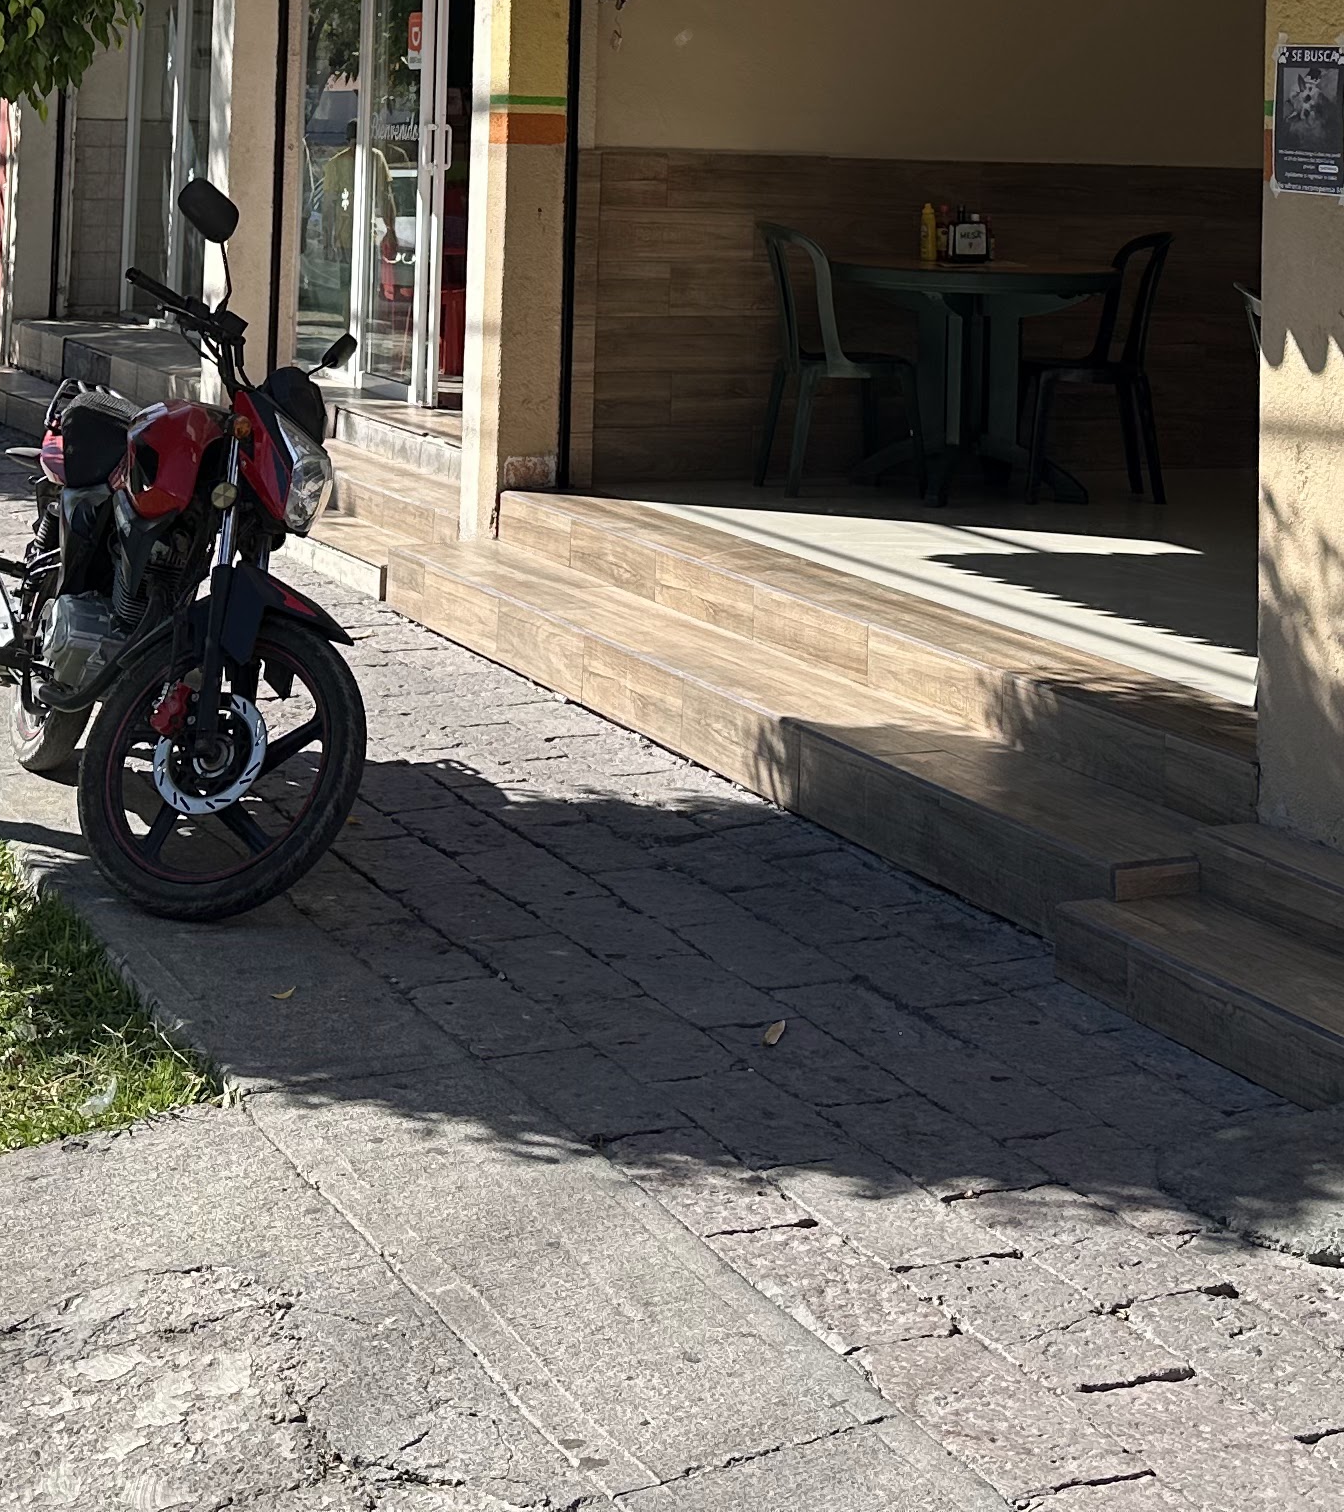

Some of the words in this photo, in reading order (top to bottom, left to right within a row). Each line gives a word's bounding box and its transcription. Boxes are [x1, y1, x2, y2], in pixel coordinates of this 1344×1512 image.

[1291, 49, 1303, 62] SE
[1304, 49, 1340, 63] BUSCA
[371, 111, 420, 142] Bienvenido
